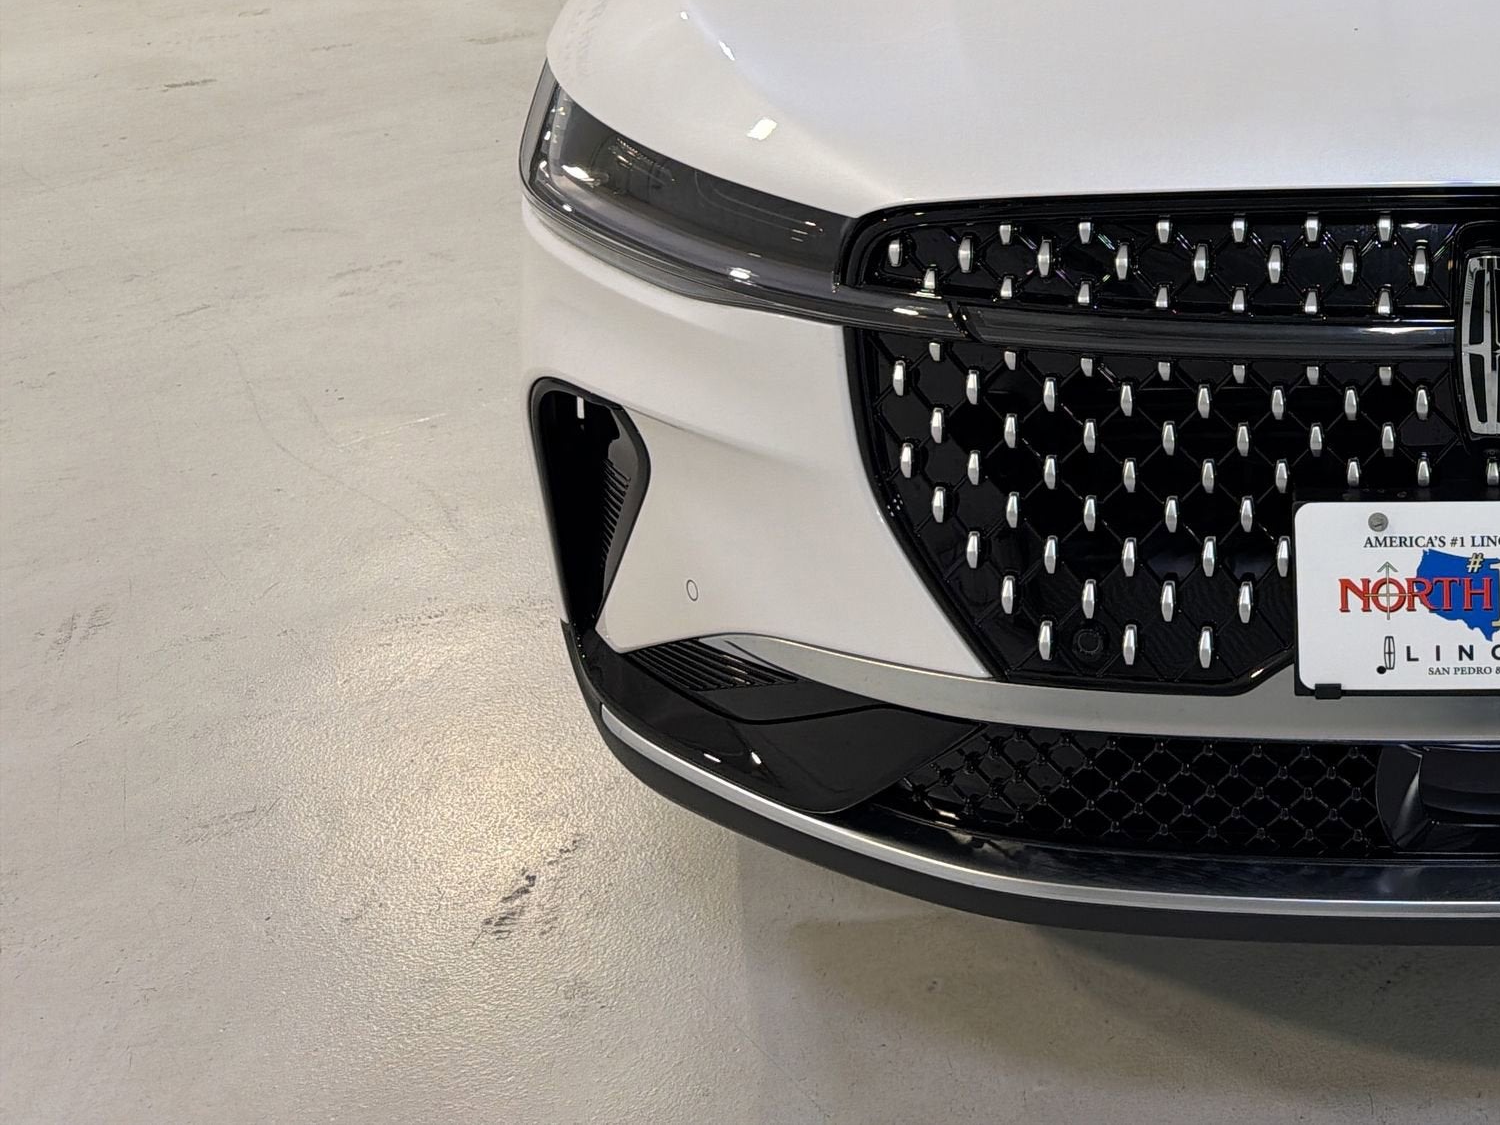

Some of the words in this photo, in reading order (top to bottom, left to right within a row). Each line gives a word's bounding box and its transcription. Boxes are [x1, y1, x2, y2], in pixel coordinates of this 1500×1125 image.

[1363, 535, 1446, 548] AMERICA'S
[1450, 536, 1466, 548] #1
[1338, 576, 1494, 613] NORTH
[1428, 666, 1450, 675] SAN
[1453, 666, 1492, 675] PEDRO
